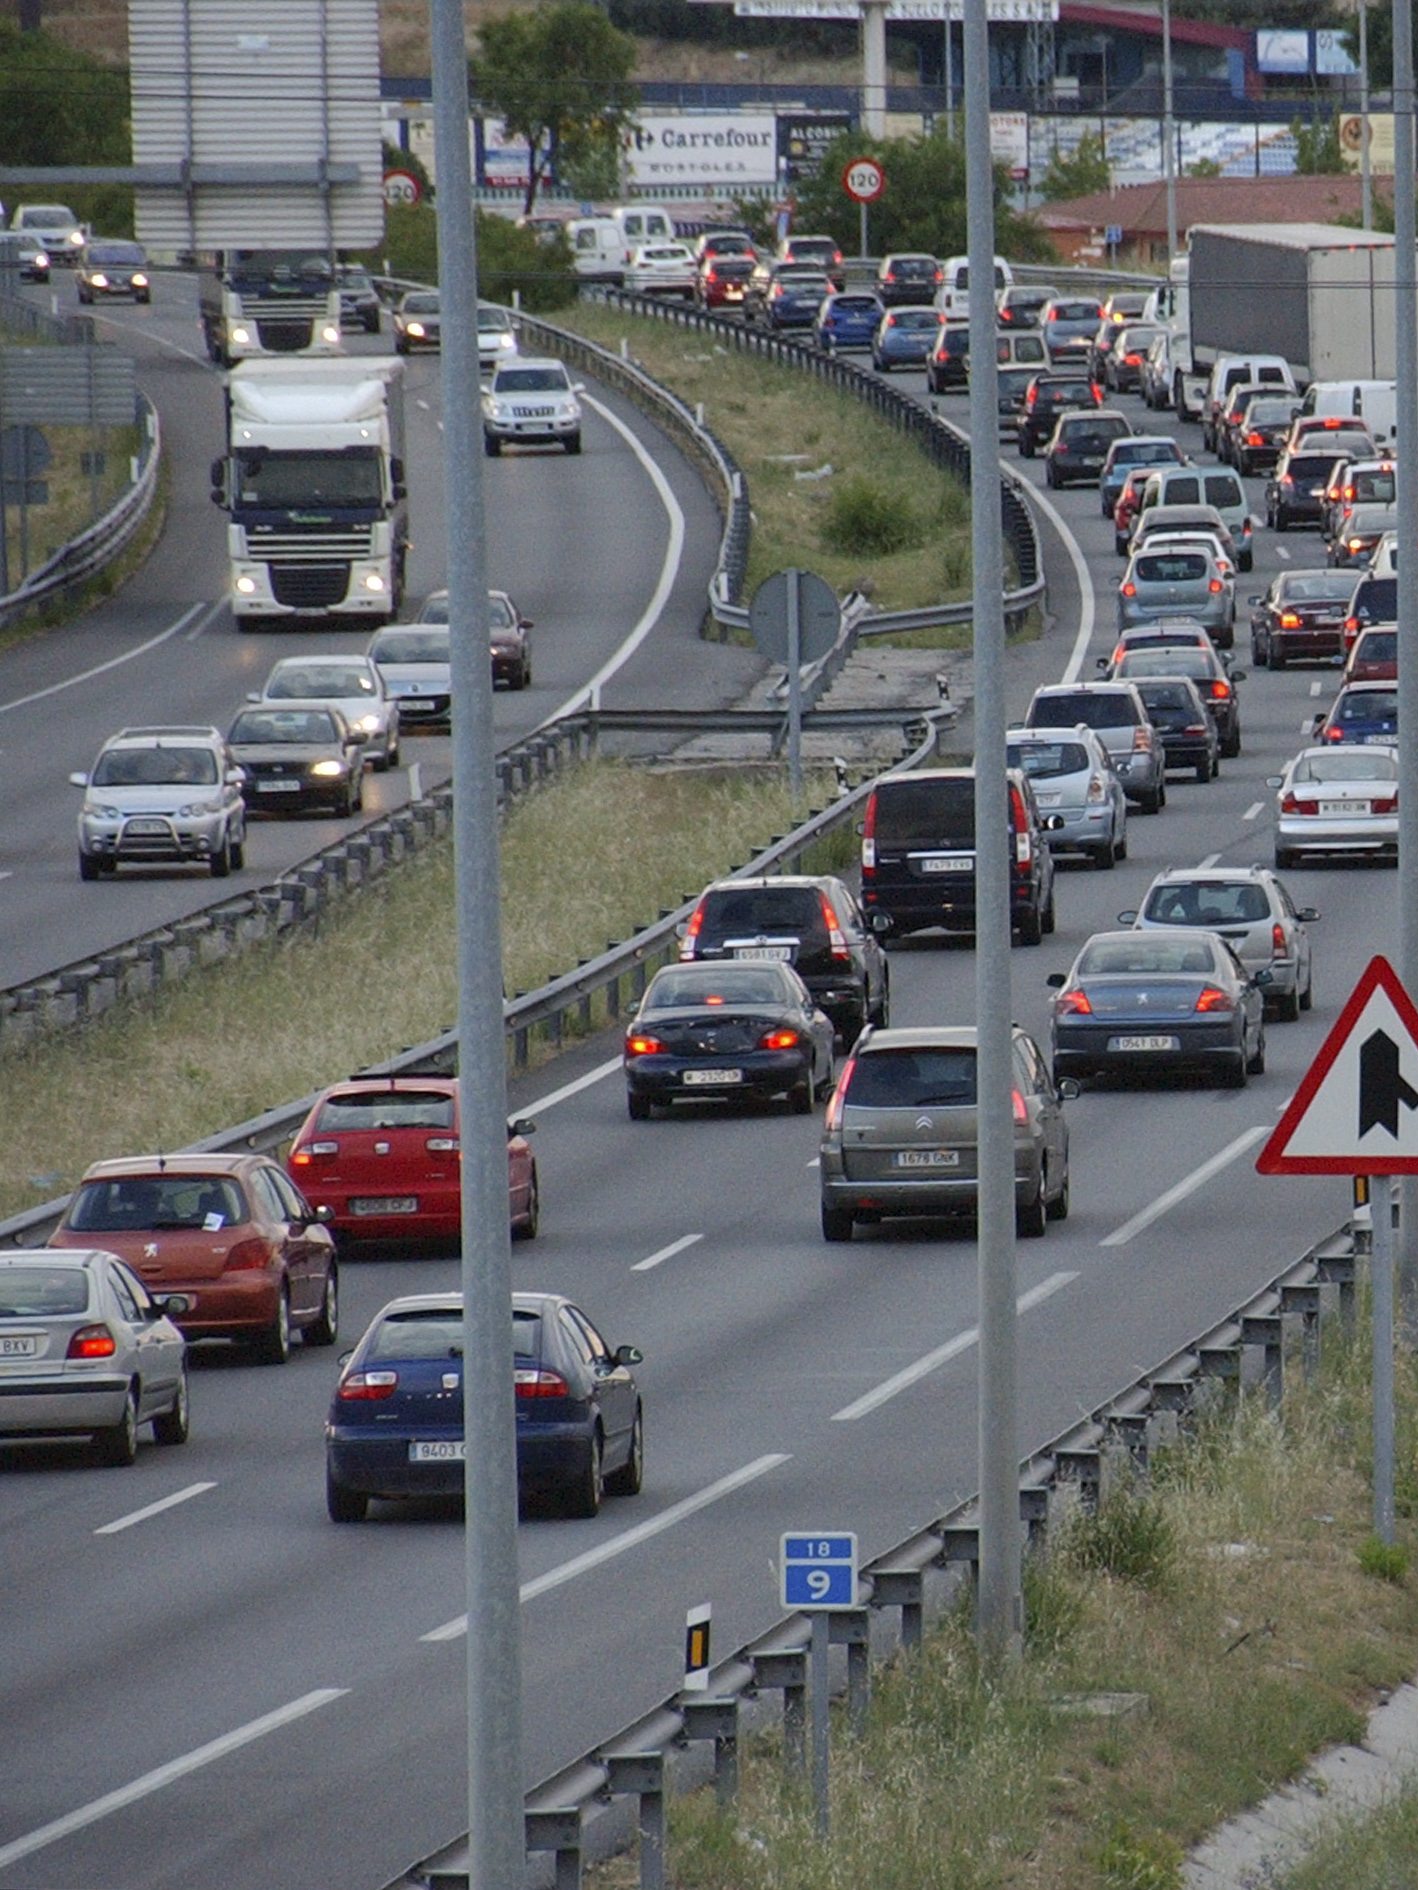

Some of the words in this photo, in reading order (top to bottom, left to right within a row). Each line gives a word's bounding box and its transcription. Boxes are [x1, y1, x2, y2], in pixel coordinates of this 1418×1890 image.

[662, 128, 772, 148] Carrefour
[850, 173, 879, 187] 120
[421, 1443, 456, 1458] 9403
[807, 1541, 830, 1557] 18
[806, 1569, 831, 1600] 9
